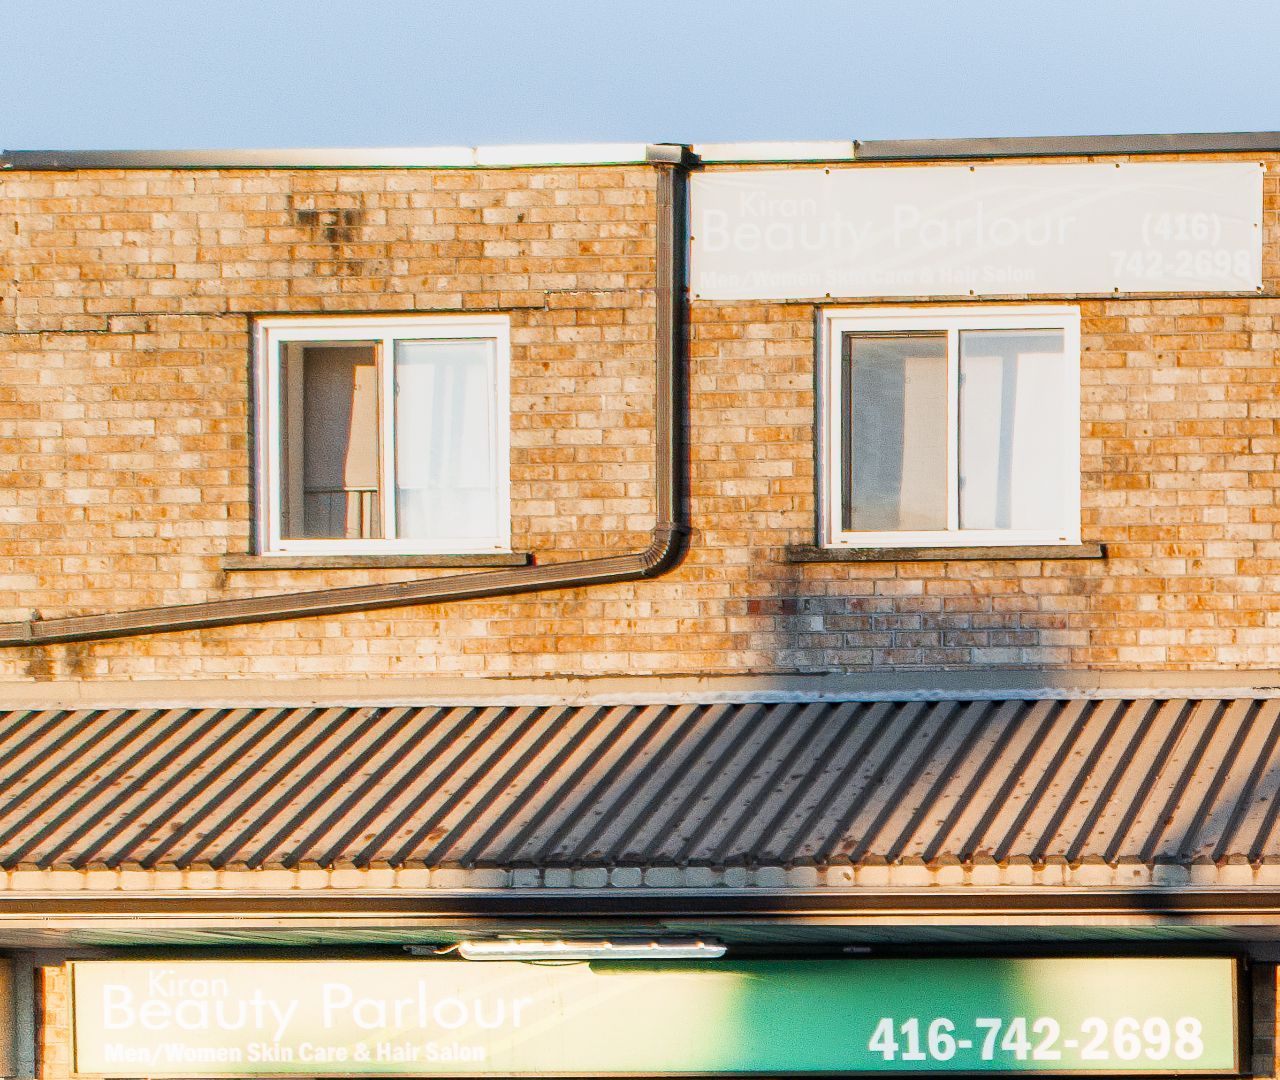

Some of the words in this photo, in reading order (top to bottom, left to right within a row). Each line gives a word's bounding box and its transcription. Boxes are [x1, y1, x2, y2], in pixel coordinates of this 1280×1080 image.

[702, 210, 873, 264] Beauty
[906, 200, 1076, 251] Parlour
[1141, 213, 1220, 243] (416)
[1110, 250, 1251, 278] 742-2698
[148, 969, 230, 997] Kiran
[102, 983, 300, 1040] Beauty
[324, 980, 535, 1030] Parlour
[104, 1043, 240, 1063] Men/Women
[247, 1042, 292, 1062] Skin
[300, 1043, 348, 1062] Care
[353, 1043, 370, 1061] &
[376, 1042, 420, 1062] Hair
[426, 1042, 486, 1062] Salon
[868, 1016, 1204, 1062] 416-742-2698
